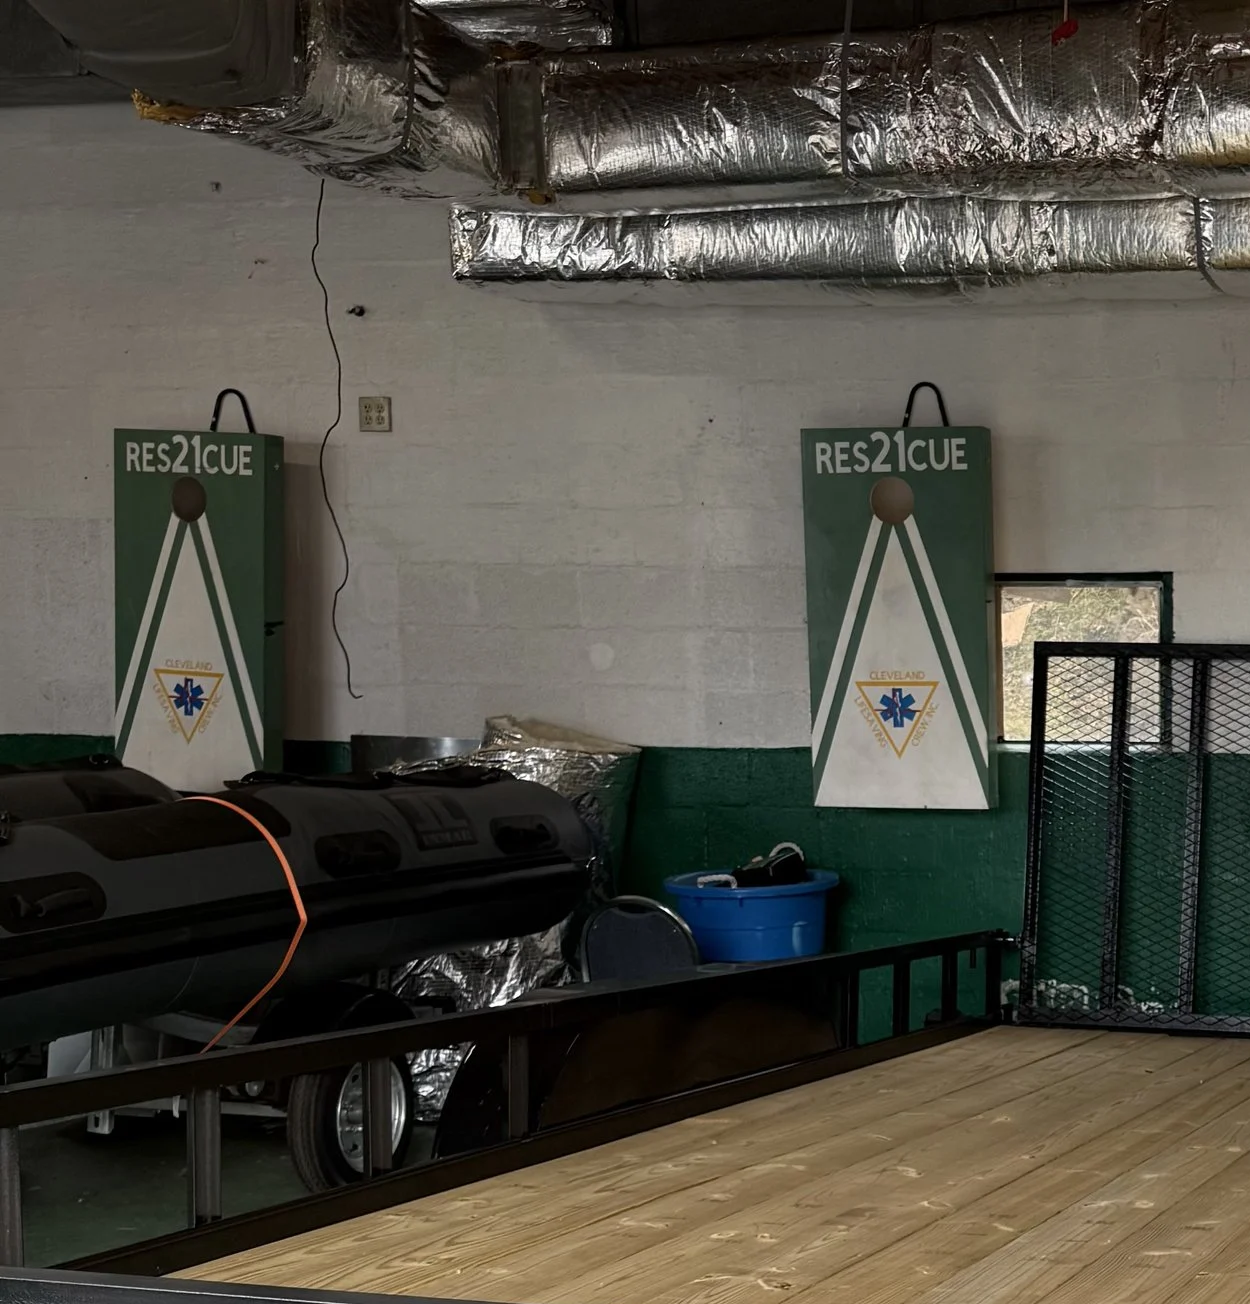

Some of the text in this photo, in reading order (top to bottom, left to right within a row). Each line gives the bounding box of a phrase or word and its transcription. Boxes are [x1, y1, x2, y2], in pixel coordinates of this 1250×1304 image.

[125, 434, 253, 477] RES21CUE
[816, 430, 969, 474] RES21CUE
[165, 658, 213, 671] CLEVELAND
[869, 671, 925, 680] CLEVELAND
[854, 695, 888, 748] LIFESAVING
